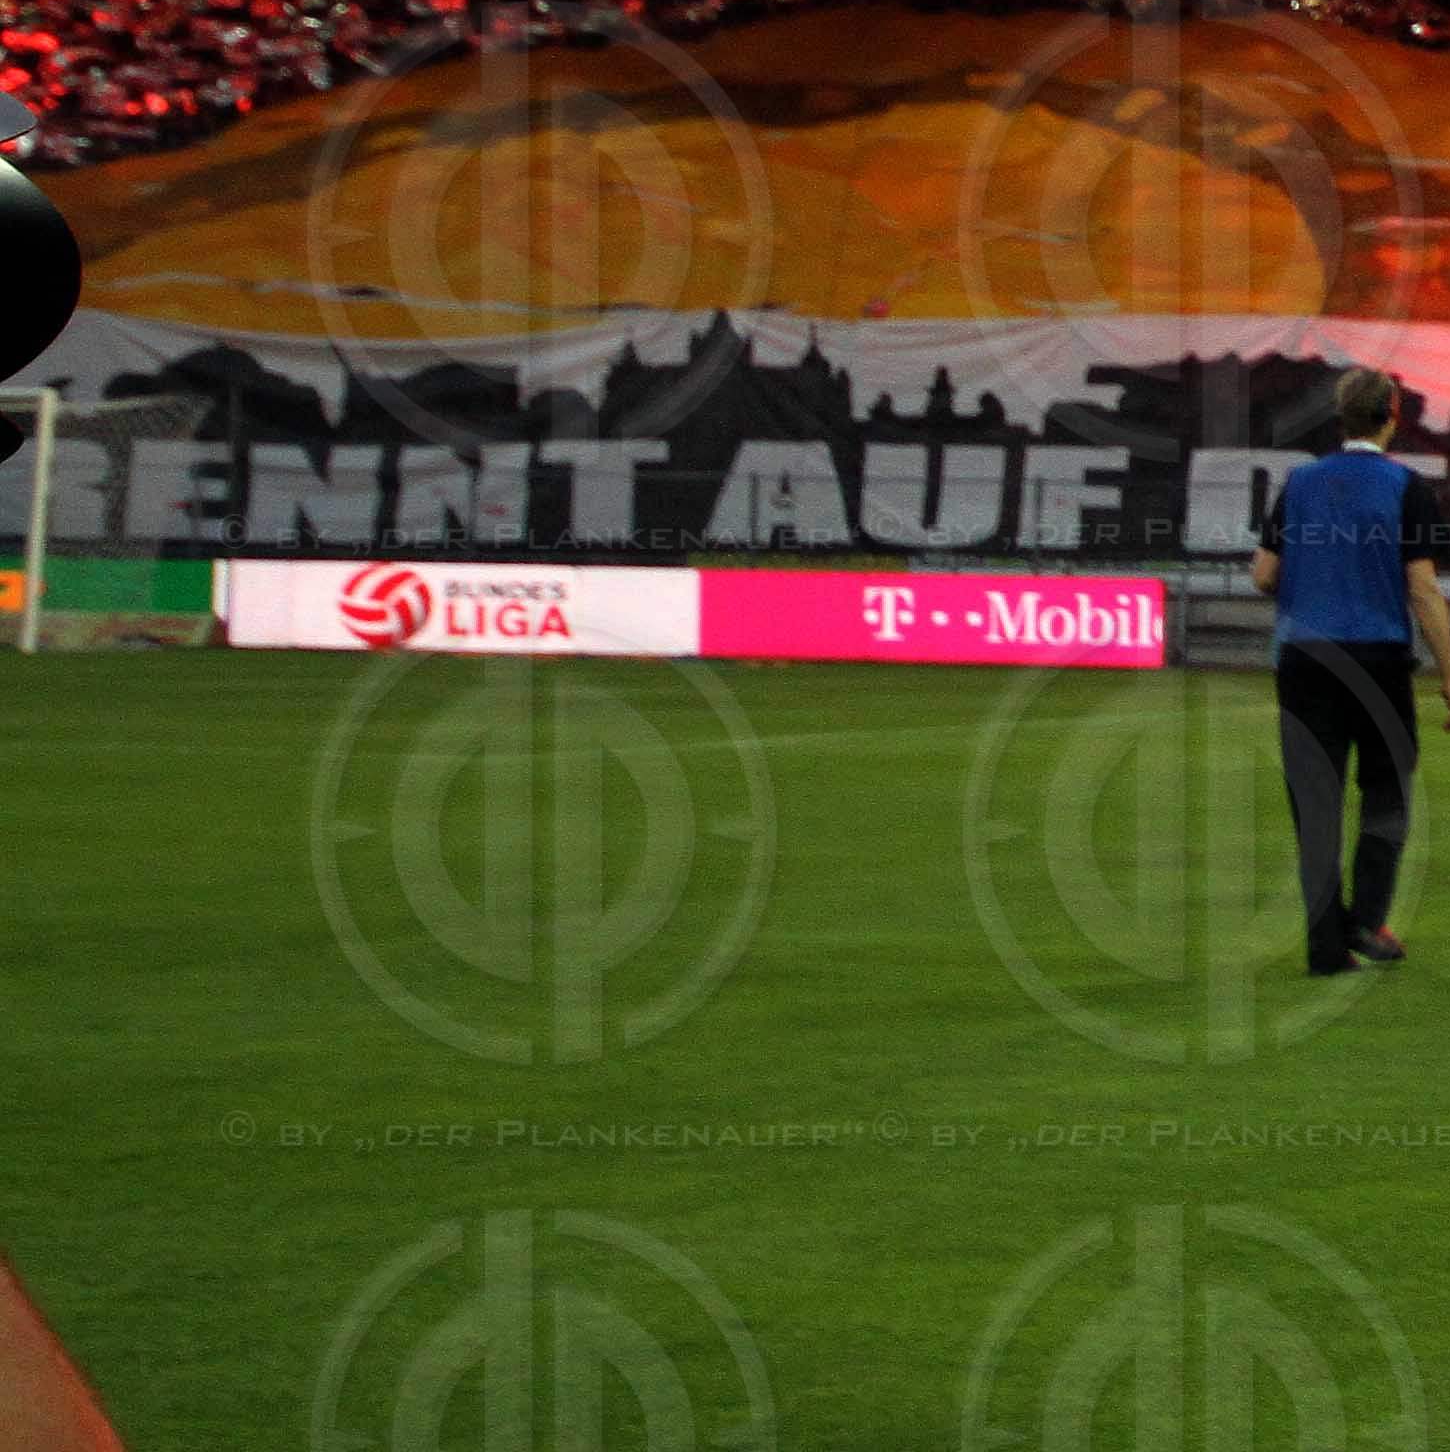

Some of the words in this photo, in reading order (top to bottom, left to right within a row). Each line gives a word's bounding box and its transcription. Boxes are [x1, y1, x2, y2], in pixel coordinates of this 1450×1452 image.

[706, 440, 1131, 549] AUF
[445, 580, 567, 600] BUNDES
[445, 602, 572, 638] LIGA
